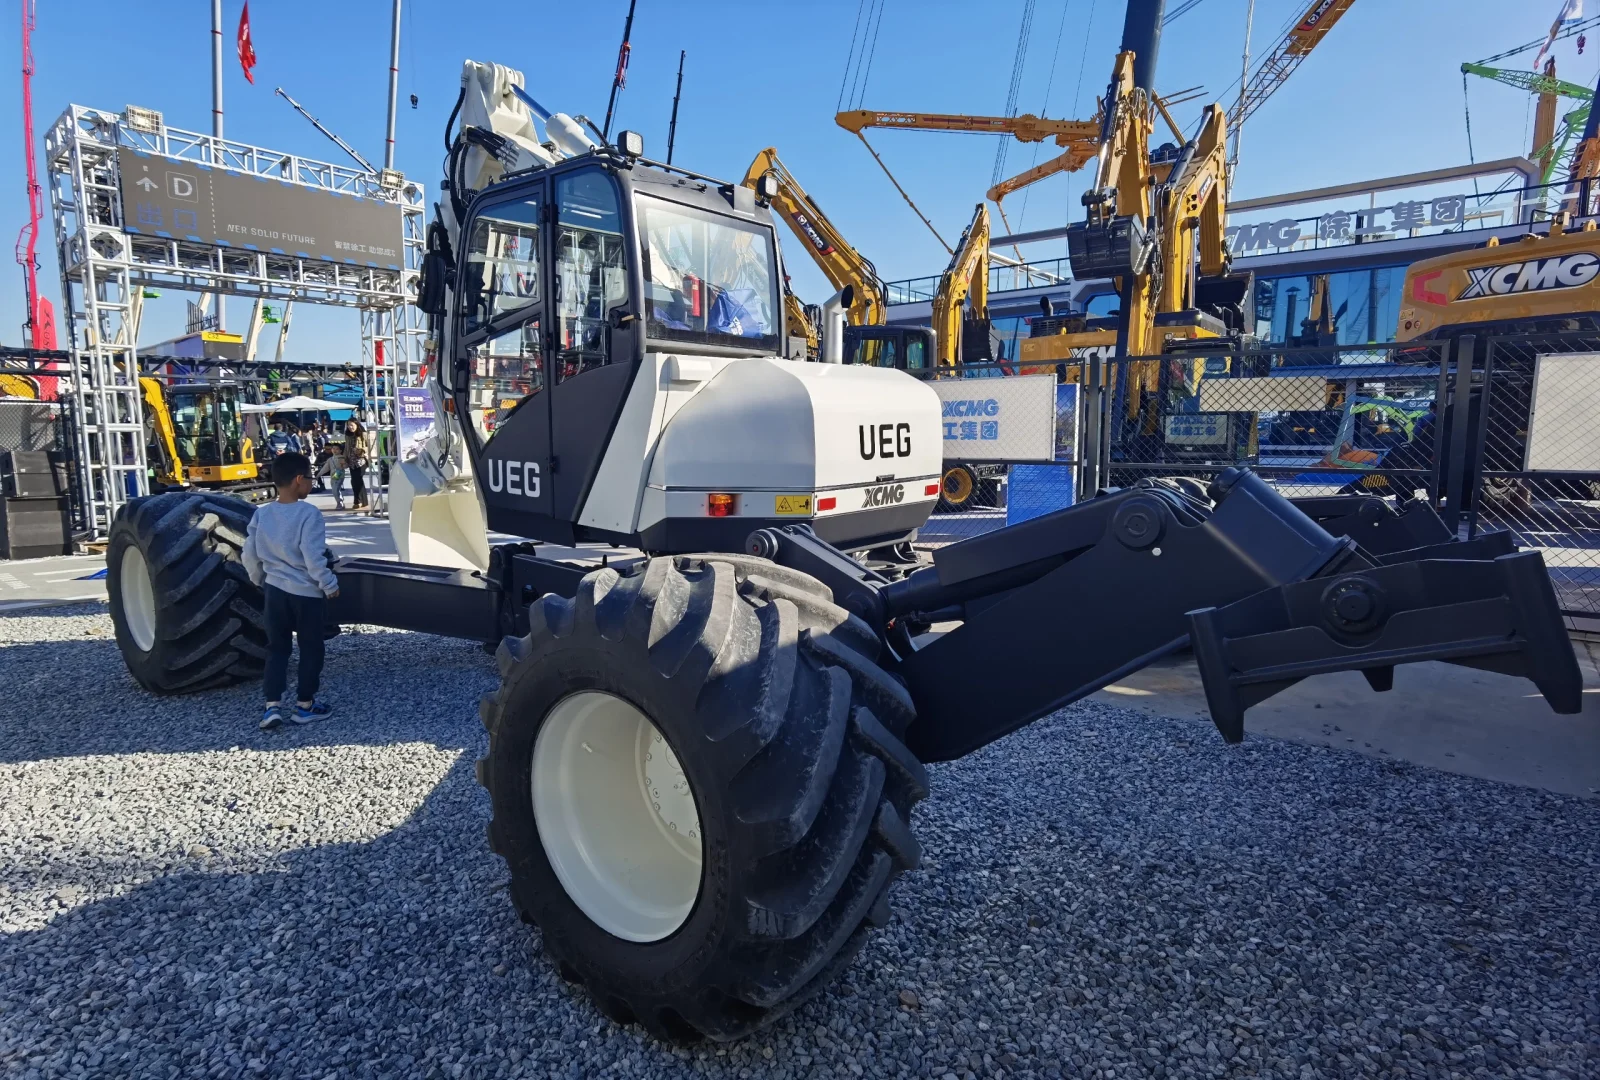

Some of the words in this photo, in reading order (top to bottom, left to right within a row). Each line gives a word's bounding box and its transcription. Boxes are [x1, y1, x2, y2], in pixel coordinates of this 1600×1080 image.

[173, 178, 193, 196] D
[137, 203, 197, 231] 出口
[1319, 194, 1466, 241] 徐工集团
[250, 228, 279, 239] SOLID
[282, 233, 316, 245] FUTURE
[803, 223, 824, 249] XCMG
[1459, 253, 1600, 299] XCMG
[405, 404, 423, 412] ET121
[942, 399, 999, 417] XCMG
[859, 423, 911, 461] UEG
[488, 459, 541, 498] UEG
[861, 484, 905, 509] XCMG
